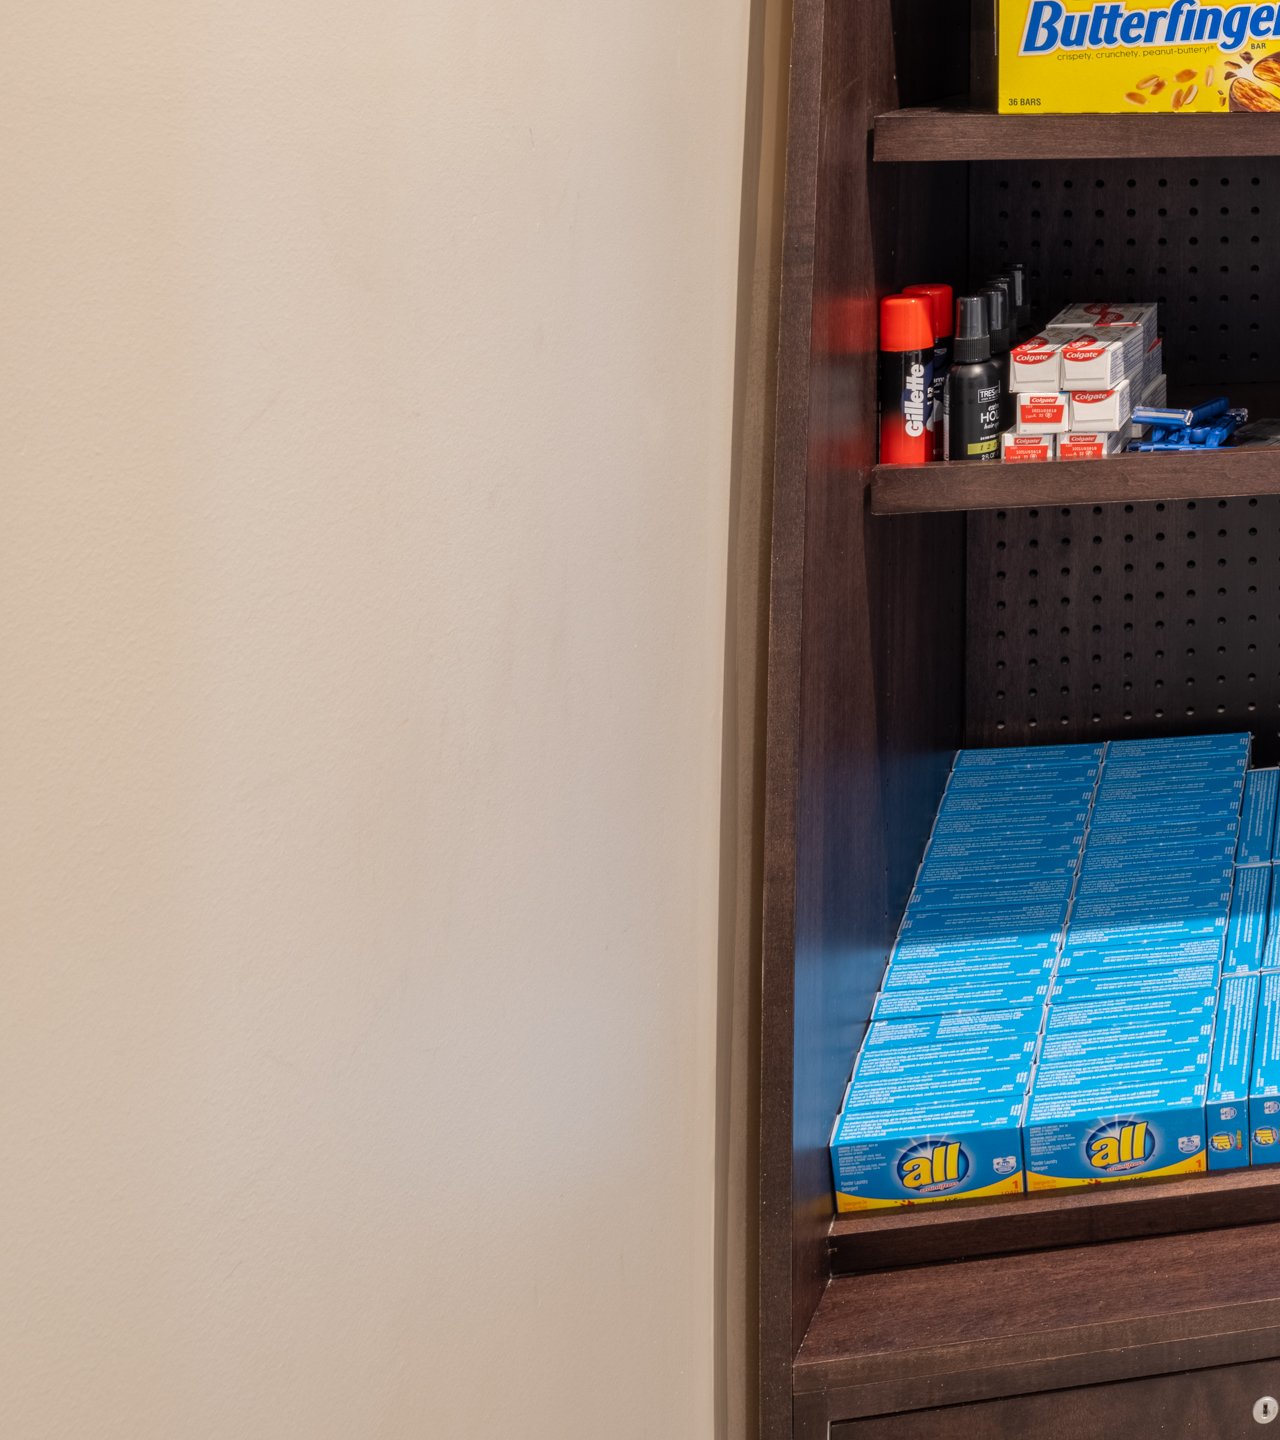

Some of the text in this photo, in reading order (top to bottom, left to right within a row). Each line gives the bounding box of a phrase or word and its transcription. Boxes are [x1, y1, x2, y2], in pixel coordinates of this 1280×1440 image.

[1057, 52, 1093, 61] crispety,
[1096, 50, 1140, 59] crunchety,
[1008, 98, 1042, 107] 36 BARS
[1016, 354, 1048, 363] Colgate
[1066, 351, 1098, 360] Colgate
[904, 363, 925, 437] Gillette
